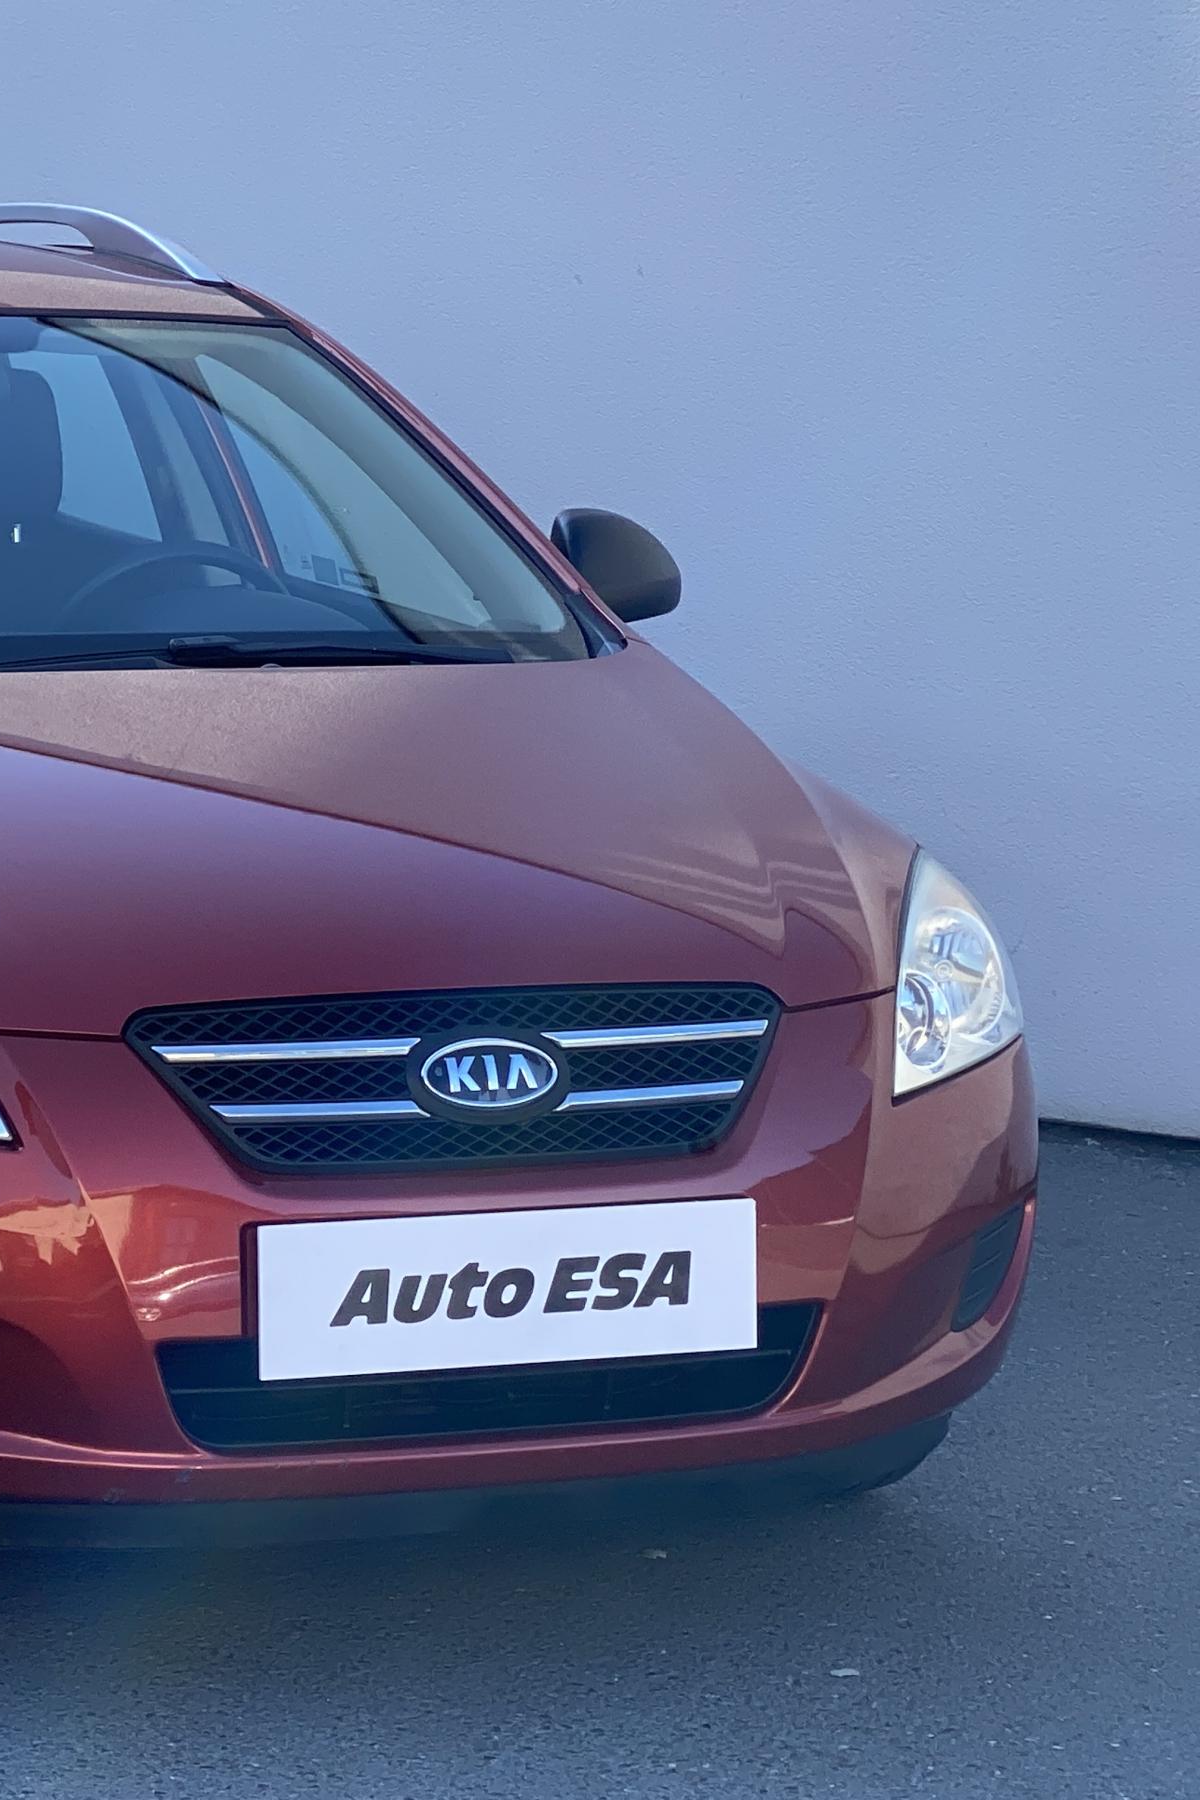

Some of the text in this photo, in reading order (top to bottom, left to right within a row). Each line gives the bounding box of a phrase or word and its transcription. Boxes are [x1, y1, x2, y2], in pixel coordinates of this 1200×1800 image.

[443, 1054, 539, 1093] KIA
[329, 1250, 692, 1328] Auto ESA
